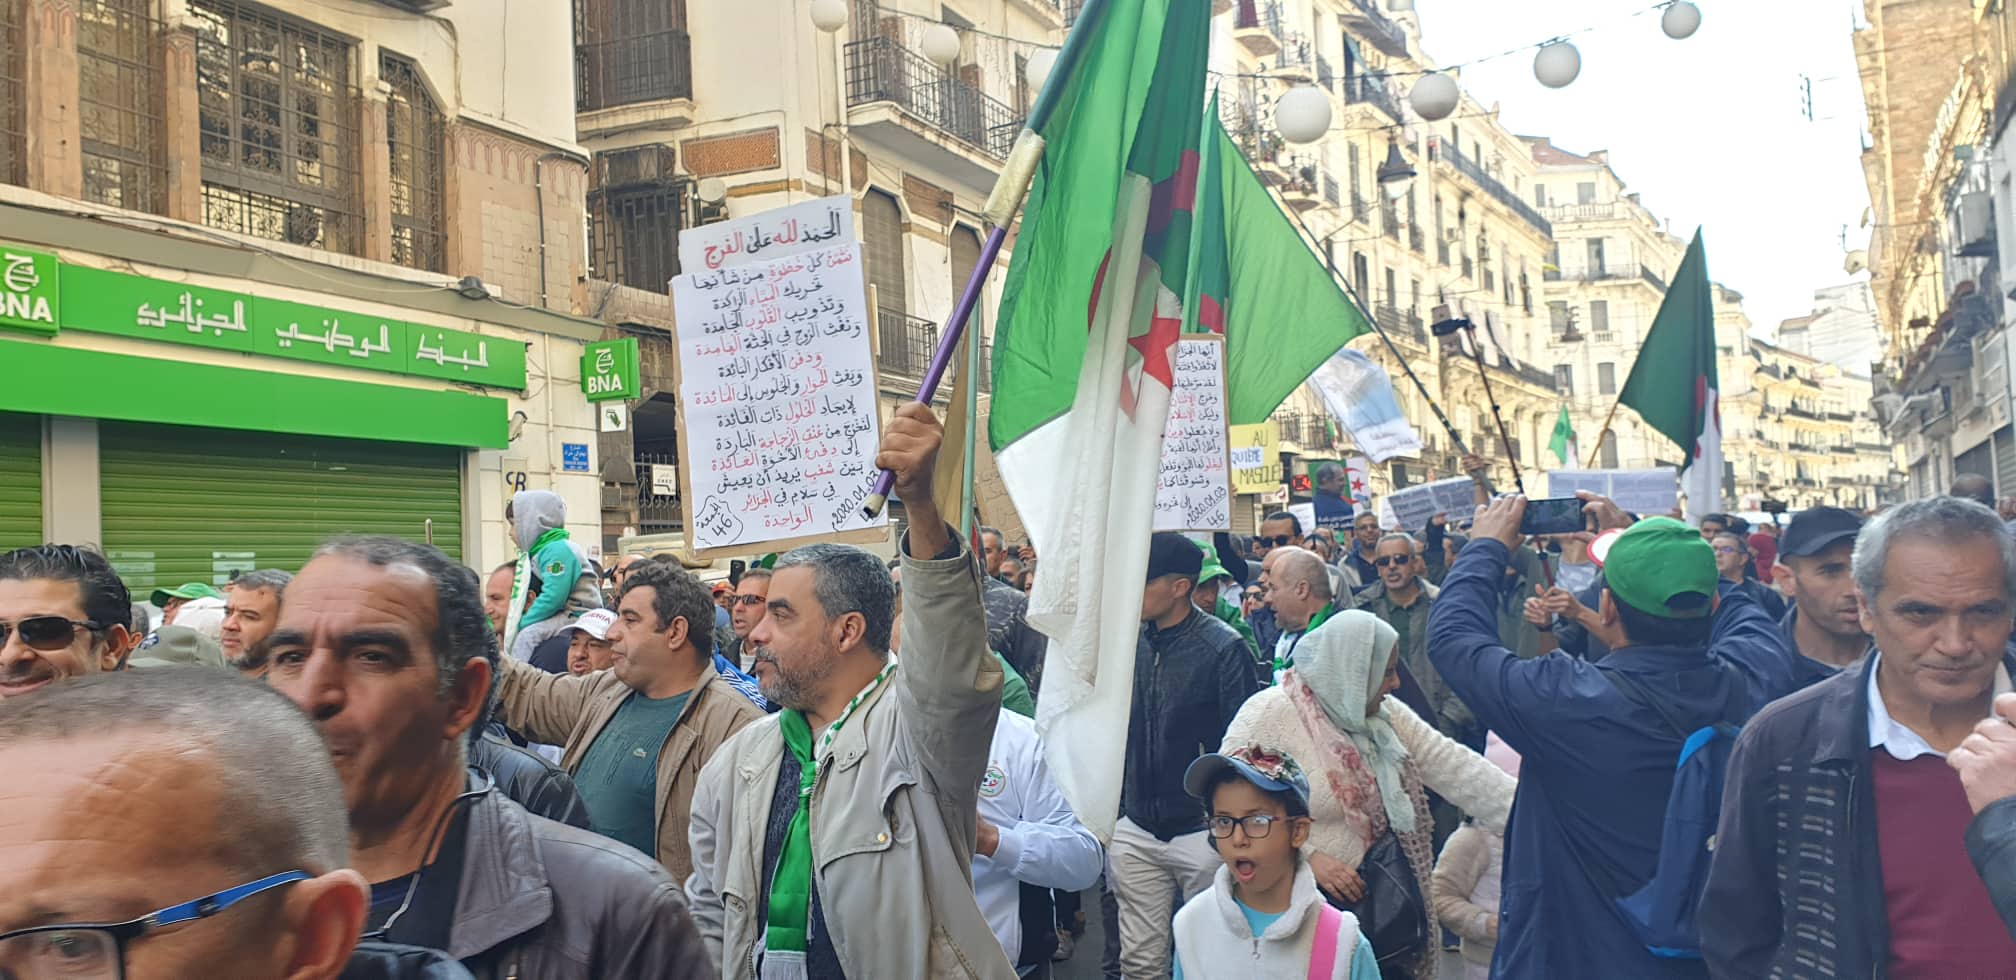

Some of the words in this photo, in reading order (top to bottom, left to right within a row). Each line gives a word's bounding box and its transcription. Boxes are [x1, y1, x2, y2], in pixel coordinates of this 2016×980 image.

[136, 291, 248, 336] الجزائري
[275, 318, 390, 357] الوطني
[415, 332, 489, 371] البنك
[588, 374, 623, 393] BNA
[712, 513, 732, 536] 46
